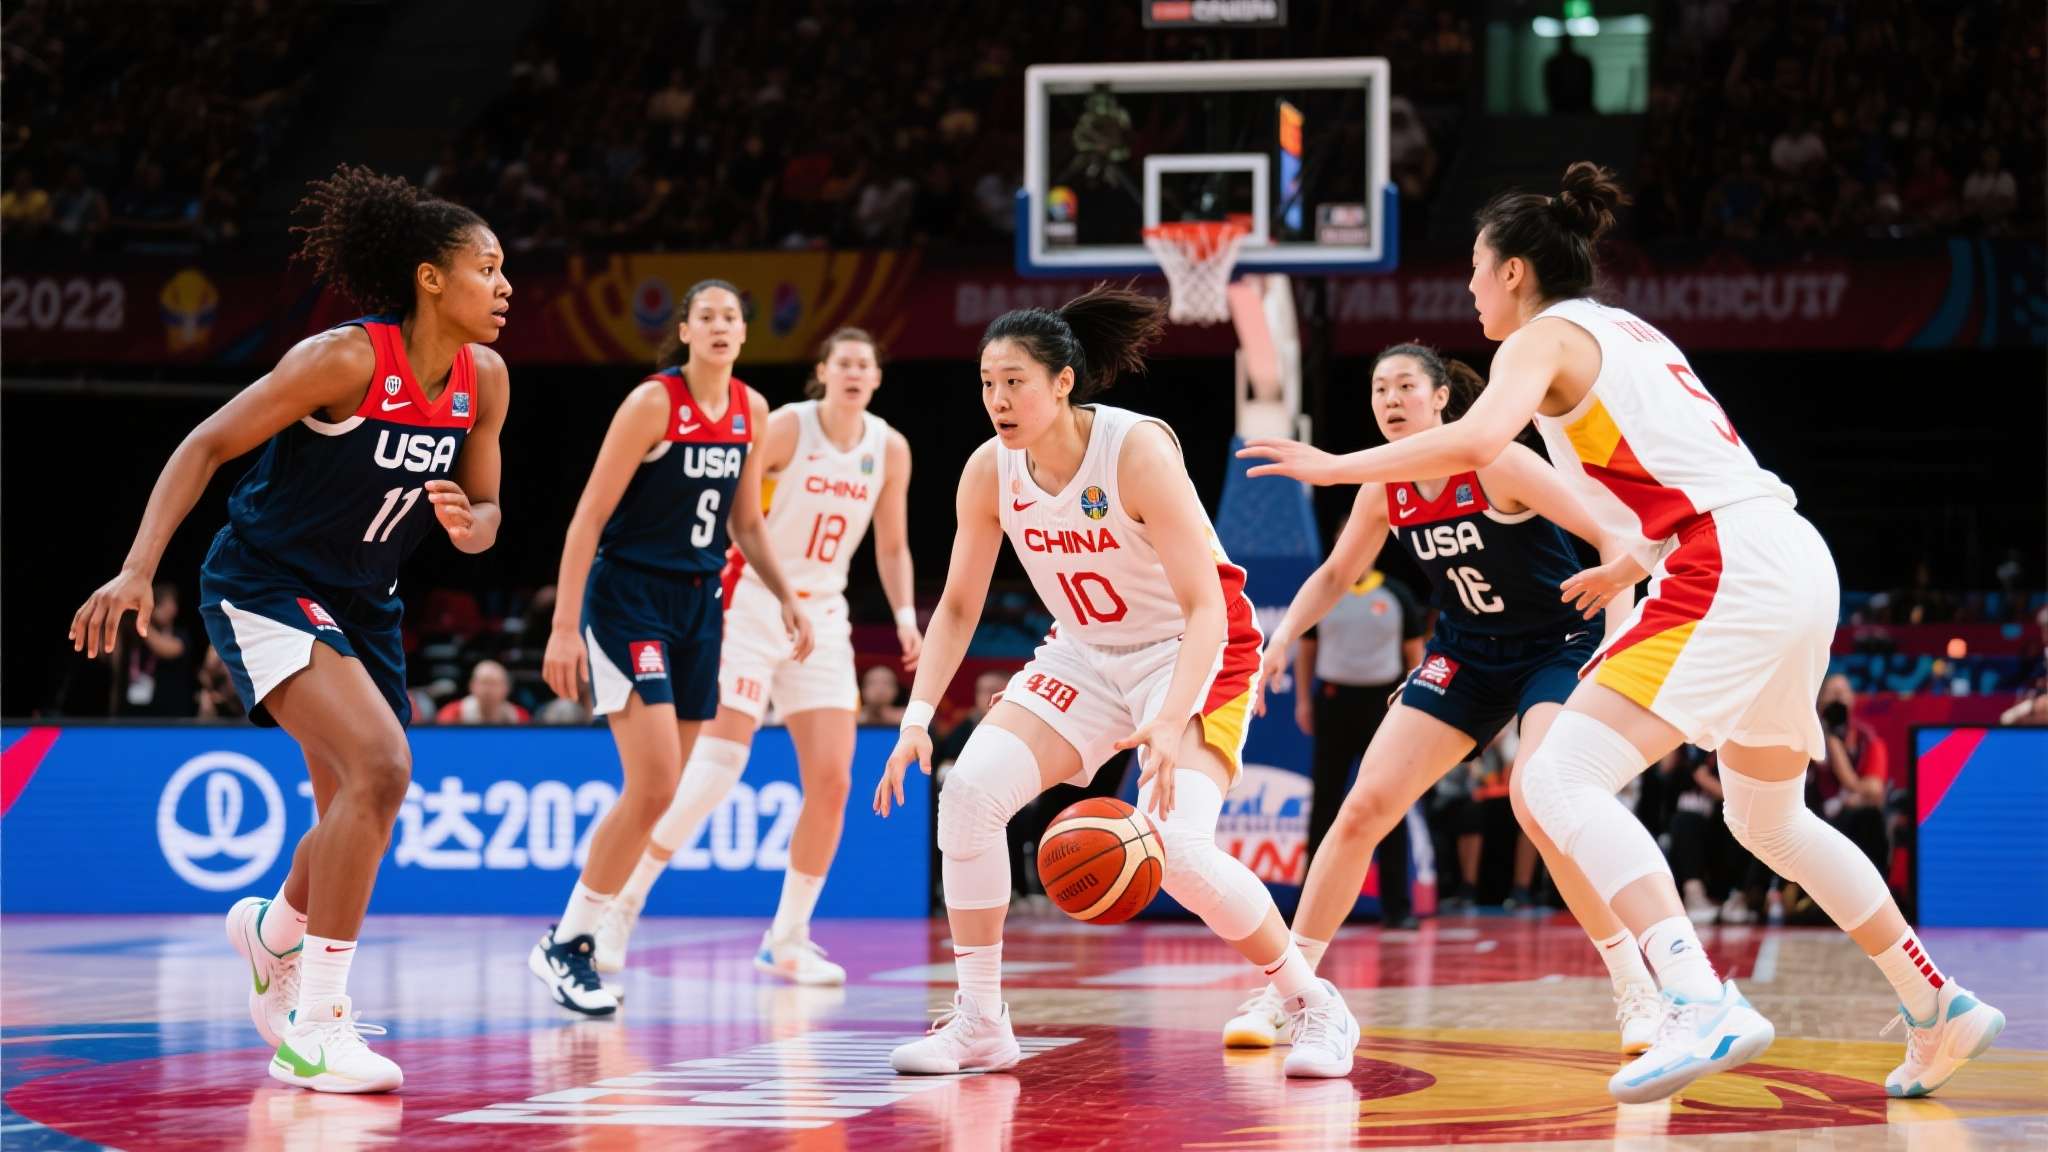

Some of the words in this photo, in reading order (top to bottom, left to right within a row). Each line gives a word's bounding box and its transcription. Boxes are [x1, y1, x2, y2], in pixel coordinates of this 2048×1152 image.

[374, 430, 456, 473] USA
[683, 447, 741, 479] USA
[805, 476, 868, 501] CHINA
[362, 487, 423, 543] 11
[805, 512, 847, 563] 18
[1024, 528, 1121, 553] CHINA
[1410, 521, 1485, 560] USA
[1056, 572, 1128, 625] 10
